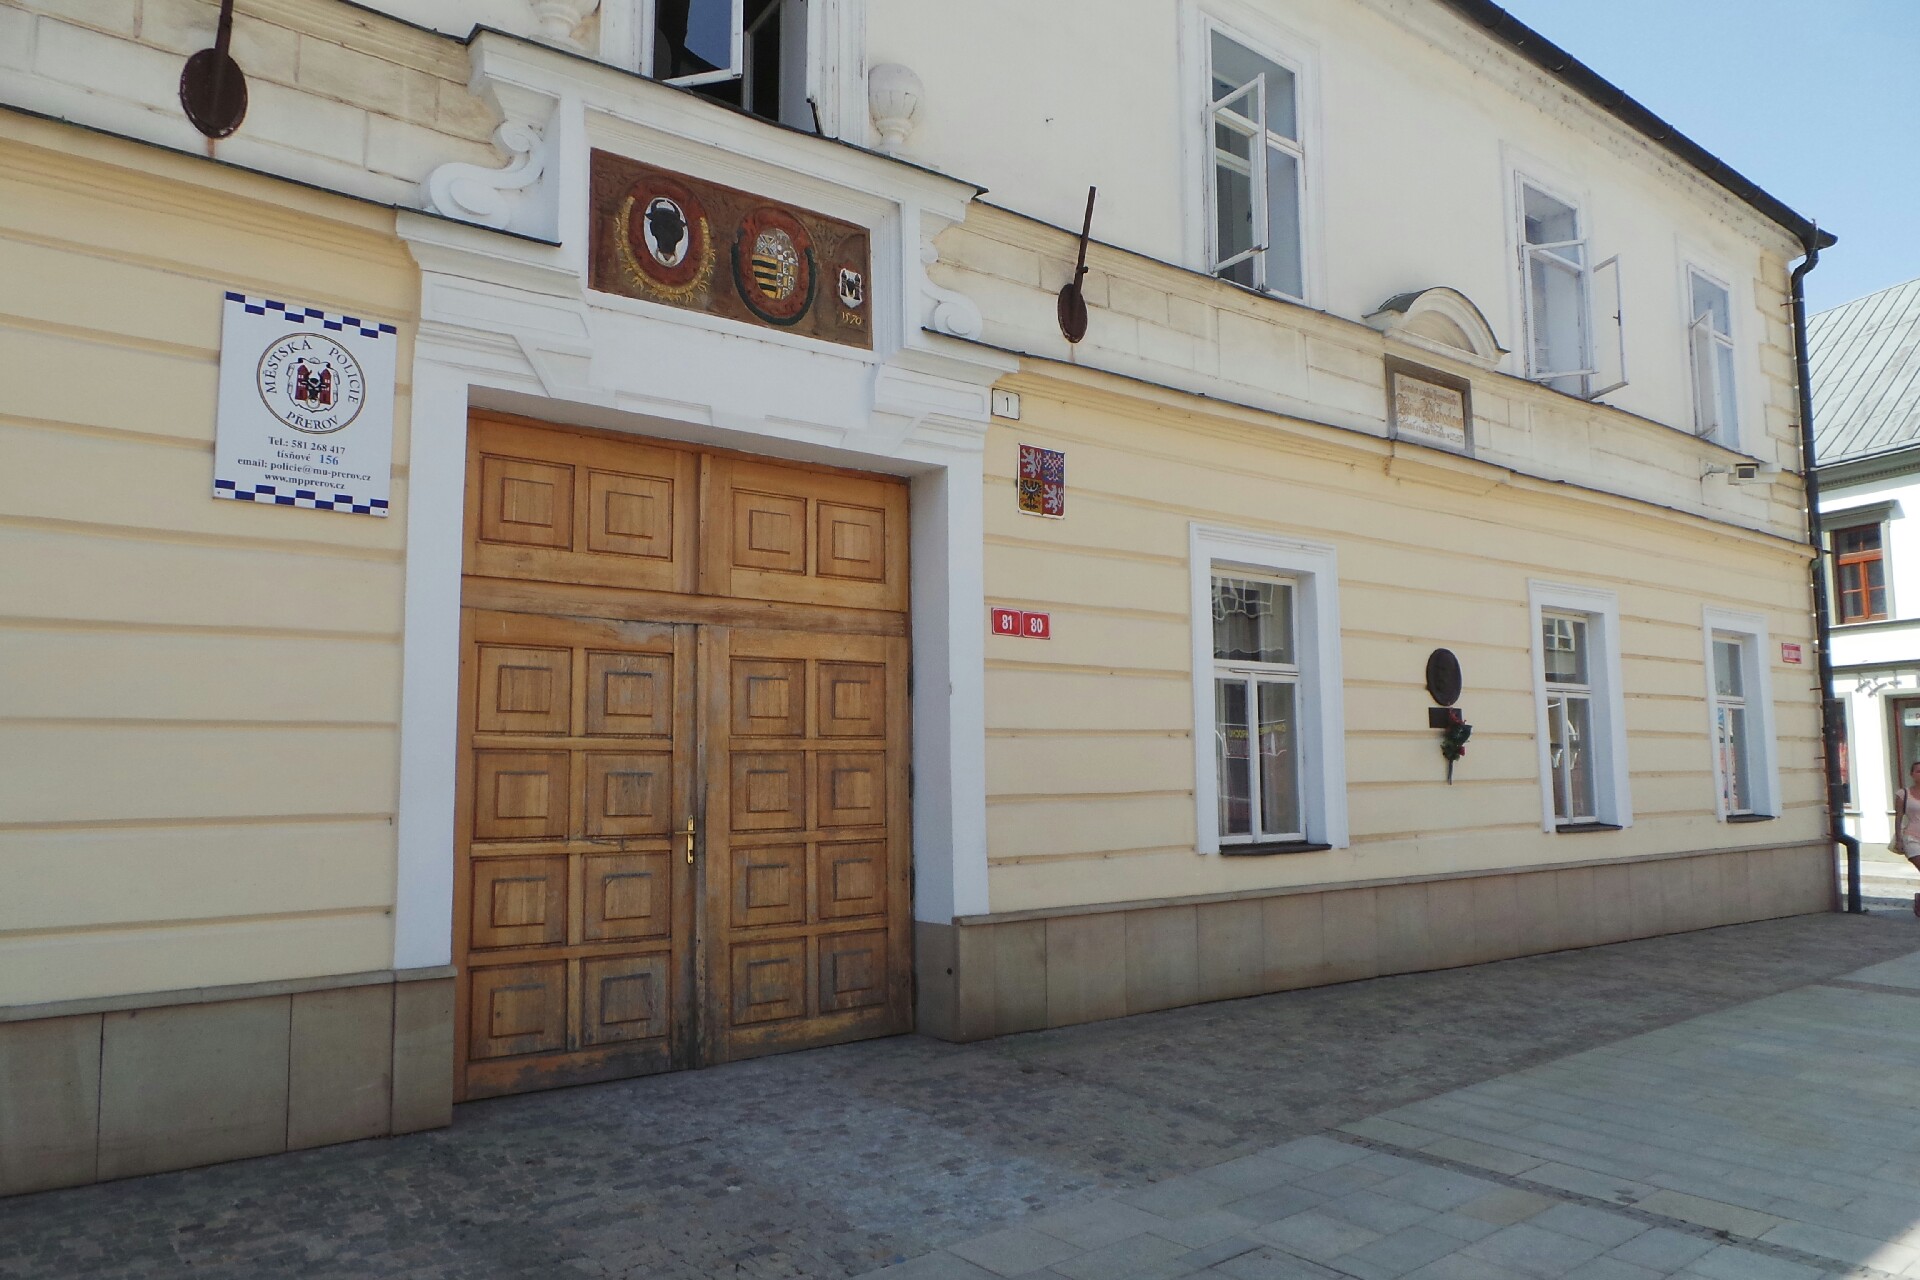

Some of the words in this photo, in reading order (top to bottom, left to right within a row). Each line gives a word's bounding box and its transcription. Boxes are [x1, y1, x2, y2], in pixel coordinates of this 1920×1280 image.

[842, 311, 862, 325] 1570
[263, 335, 313, 394] MĚSTSKÁ
[328, 347, 360, 404] POLICIE
[286, 411, 339, 430] PŘEROV
[268, 436, 289, 447] Tel.:
[291, 439, 307, 450] 581
[310, 442, 327, 452] 268
[329, 445, 346, 455] 417
[277, 450, 311, 461] tísňové
[320, 454, 339, 466] 156
[237, 458, 268, 468] email:
[270, 461, 372, 481] policie@mu-prerov.cz
[265, 473, 345, 490] www.mpprerov.cz
[1002, 614, 1012, 631] 81
[1030, 617, 1043, 633] 80
